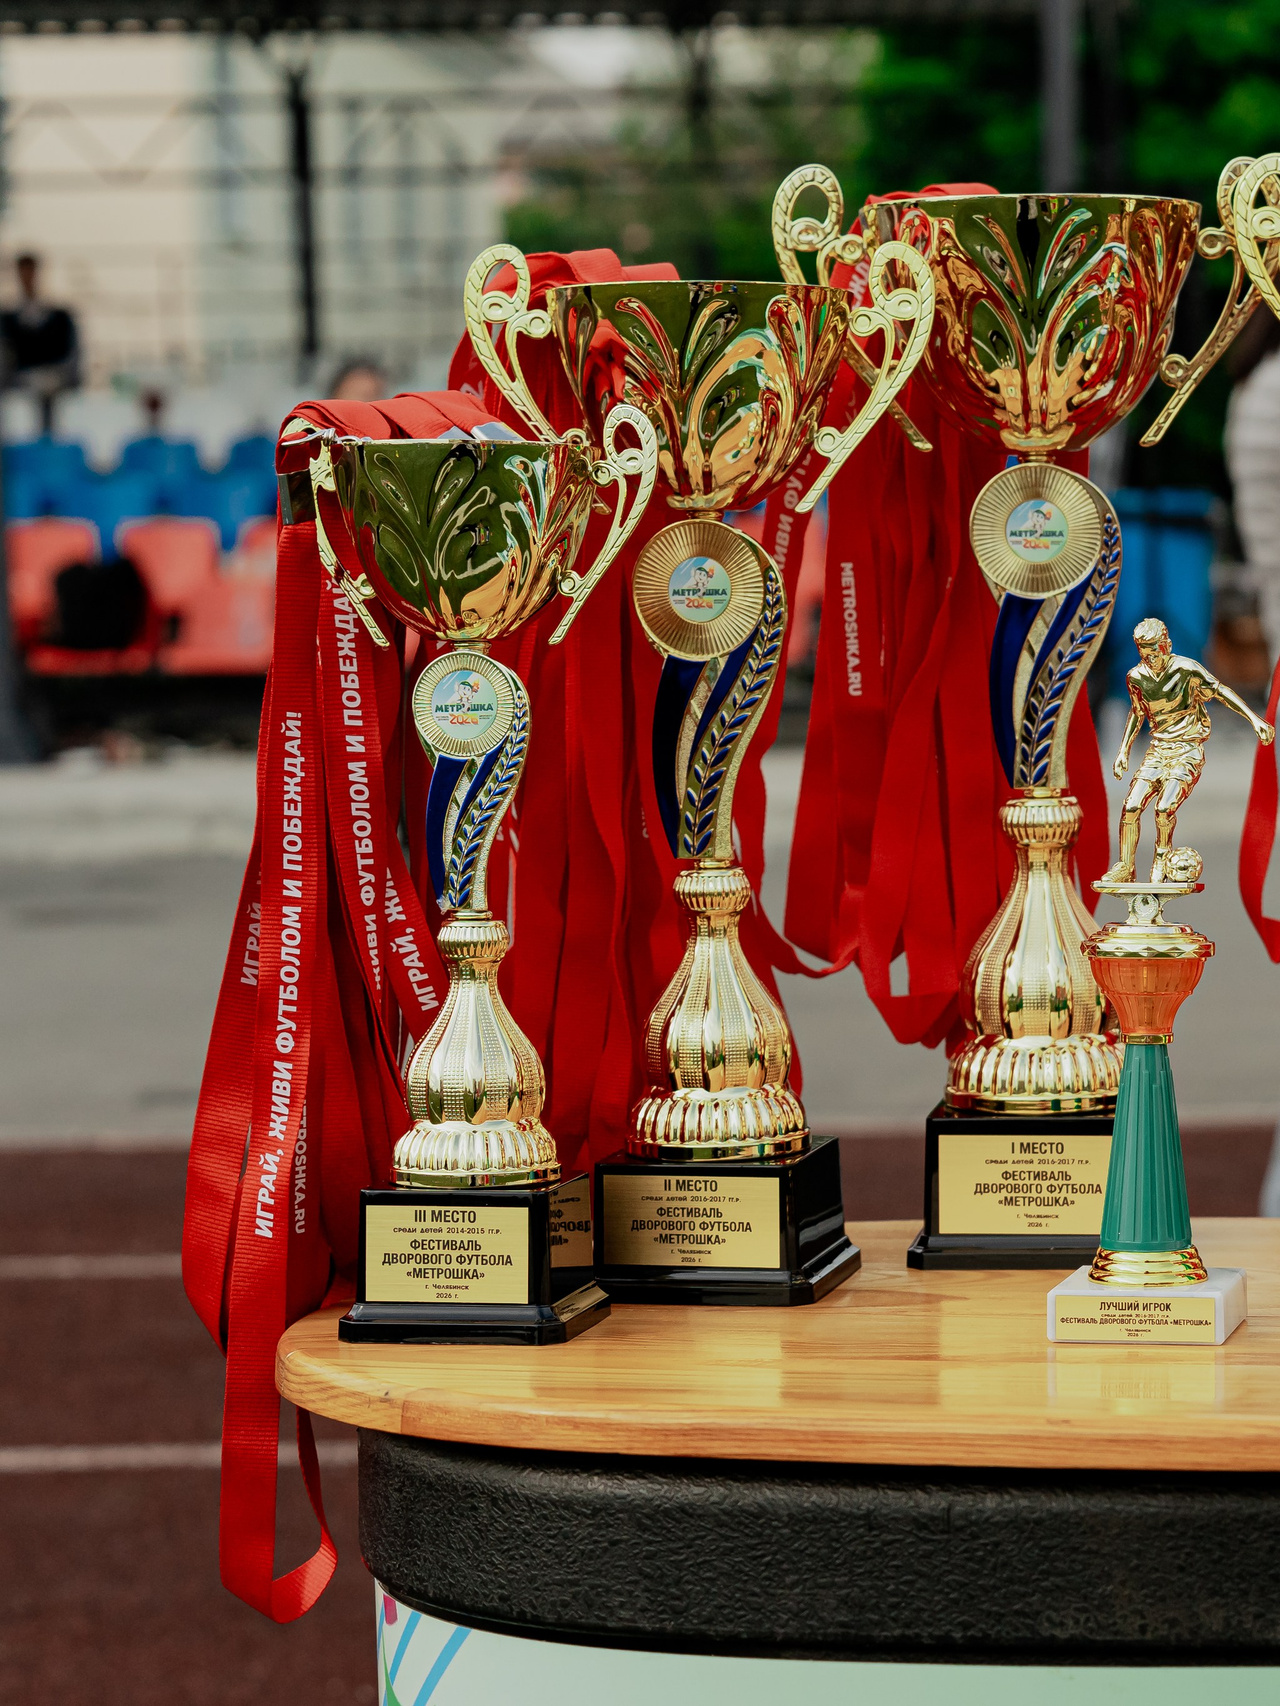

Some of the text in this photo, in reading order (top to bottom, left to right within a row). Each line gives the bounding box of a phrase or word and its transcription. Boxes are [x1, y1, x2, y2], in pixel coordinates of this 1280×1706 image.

[840, 561, 863, 697] METROSHKA.RU
[346, 734, 366, 753] И
[348, 761, 376, 906] ФУТБОЛОМ
[255, 711, 305, 1238] ИГРАЙ, ЖИВИ ФУТБОЛОМ И ПОБЕЖДАЙ!
[391, 927, 439, 1011] ИГРАЙ,
[1019, 1142, 1065, 1155] МЕСТО
[1001, 1170, 1072, 1182] ФЕСТИВАЛЬ
[664, 1179, 718, 1192] II МЕСТО
[974, 1183, 1102, 1195] ДВОРОВОГО ФУТБОЛА
[998, 1196, 1075, 1207] «МЕТРОШКА»
[414, 1210, 477, 1223] III МЕСТО
[657, 1207, 723, 1218] ФЕСТИВАЛЬ
[631, 1220, 752, 1233] ДВОРОВОГО ФУТБОЛА
[410, 1239, 482, 1251] ФЕСТИВАЛЬ
[654, 1234, 726, 1245] «МЕТРОШКА»
[382, 1253, 513, 1266] ДВОРОВОГО ФУТБОЛА
[406, 1268, 485, 1280] «МЕТРОШКА»
[1100, 1301, 1172, 1312] ЛУЧШИЙ ИГРОК
[1138, 1318, 1169, 1326] ФУТБОЛА
